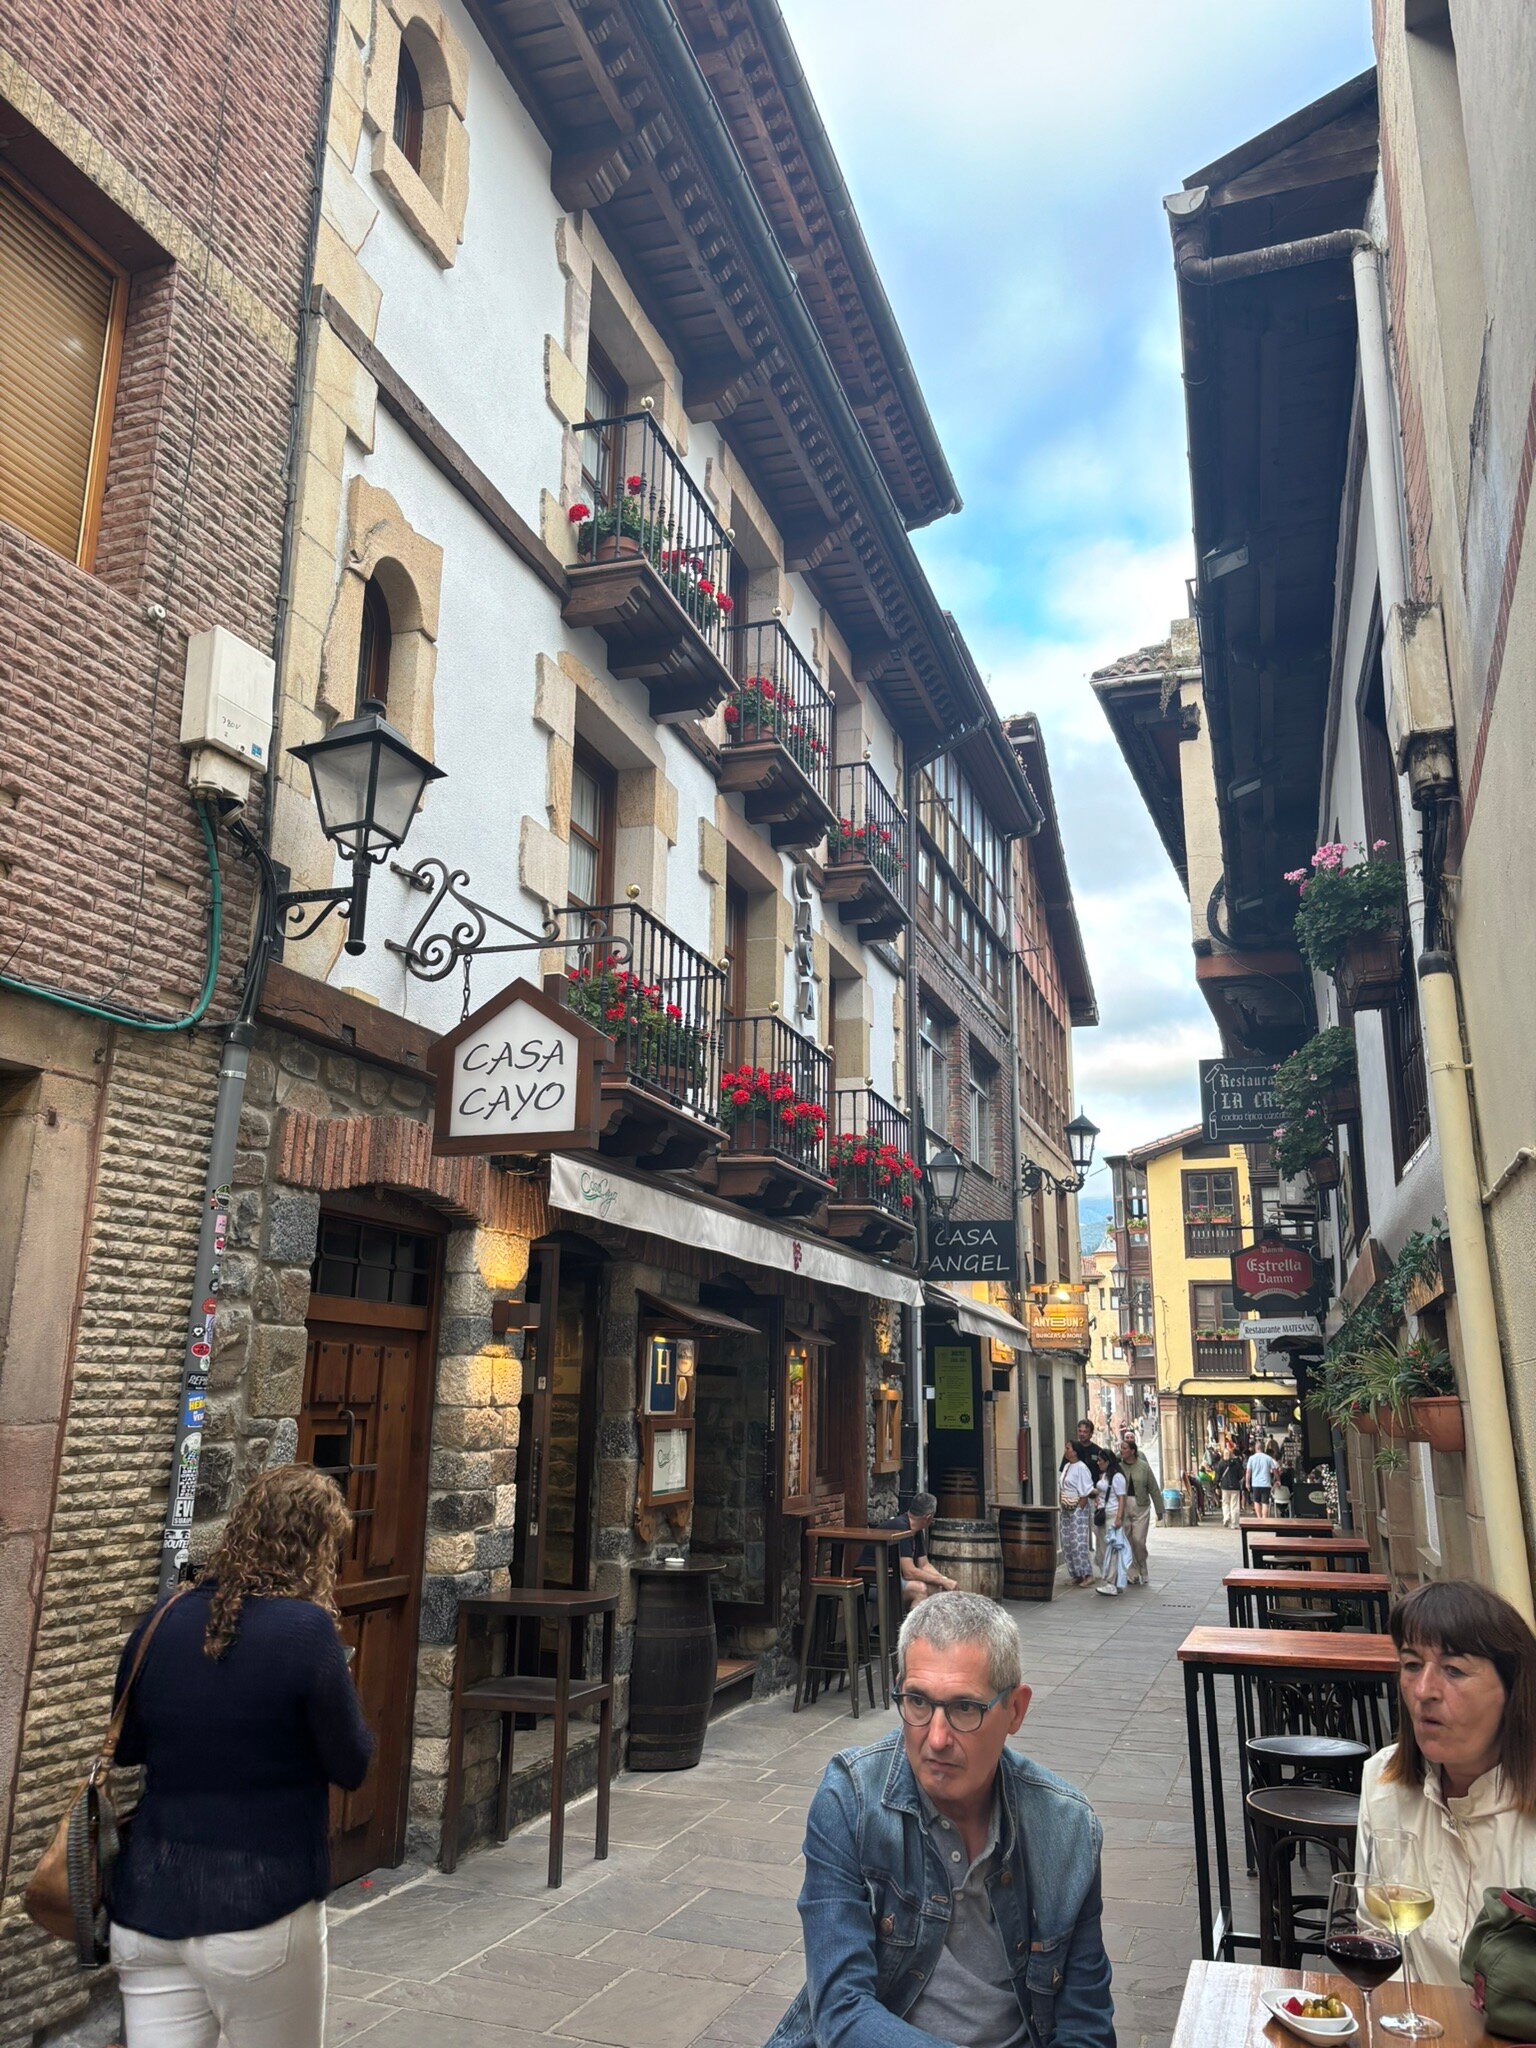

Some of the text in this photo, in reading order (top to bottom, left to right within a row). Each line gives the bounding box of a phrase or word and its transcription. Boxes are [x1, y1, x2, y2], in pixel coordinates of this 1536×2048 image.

[462, 1039, 564, 1076] CASA
[458, 1081, 566, 1121] CAYO
[1221, 1092, 1279, 1109] LA CR
[935, 1228, 998, 1246] CASA
[928, 1254, 1010, 1273] ANGEL
[1246, 1258, 1302, 1272] Estrella
[1257, 1272, 1293, 1284] Damm
[1245, 1323, 1315, 1334] Restaurante MATESANZ
[656, 1348, 671, 1384] H
